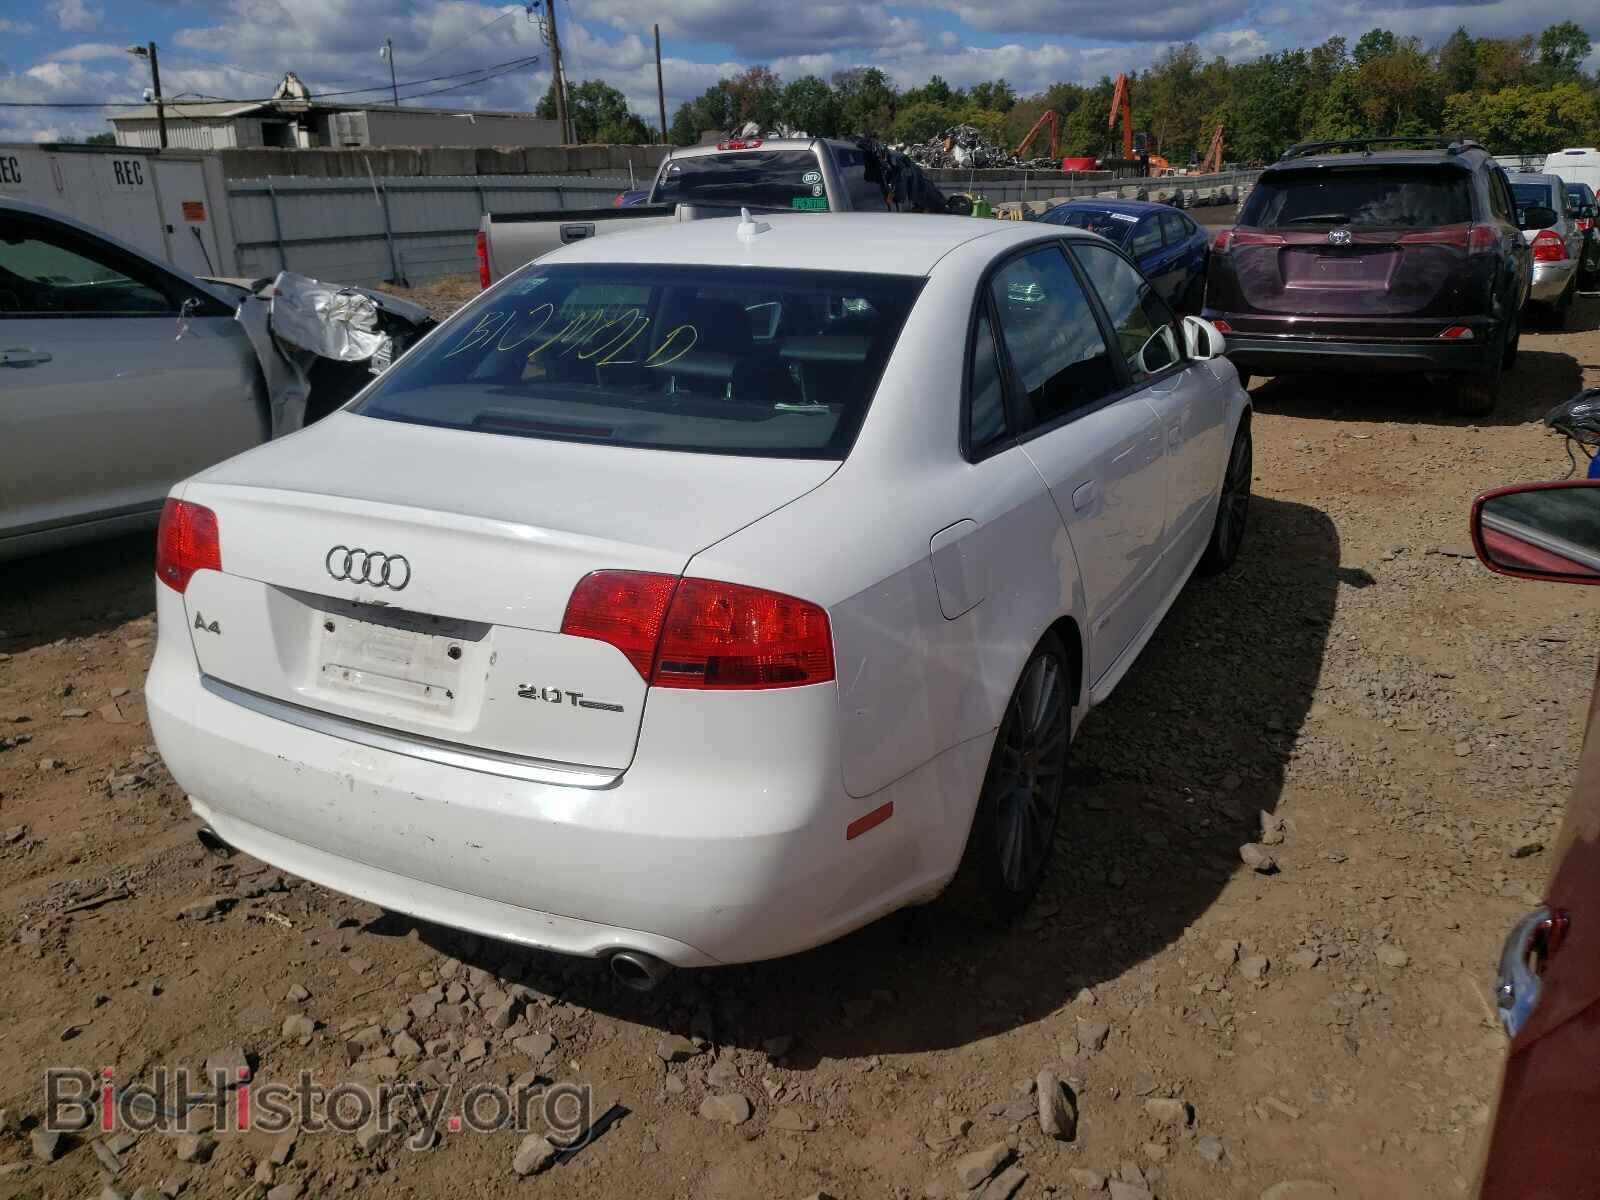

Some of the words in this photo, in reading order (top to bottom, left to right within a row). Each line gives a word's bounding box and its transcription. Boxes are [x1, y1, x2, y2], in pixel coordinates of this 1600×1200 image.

[0, 156, 22, 184] EC
[113, 160, 144, 185] REC
[194, 610, 221, 635] A4
